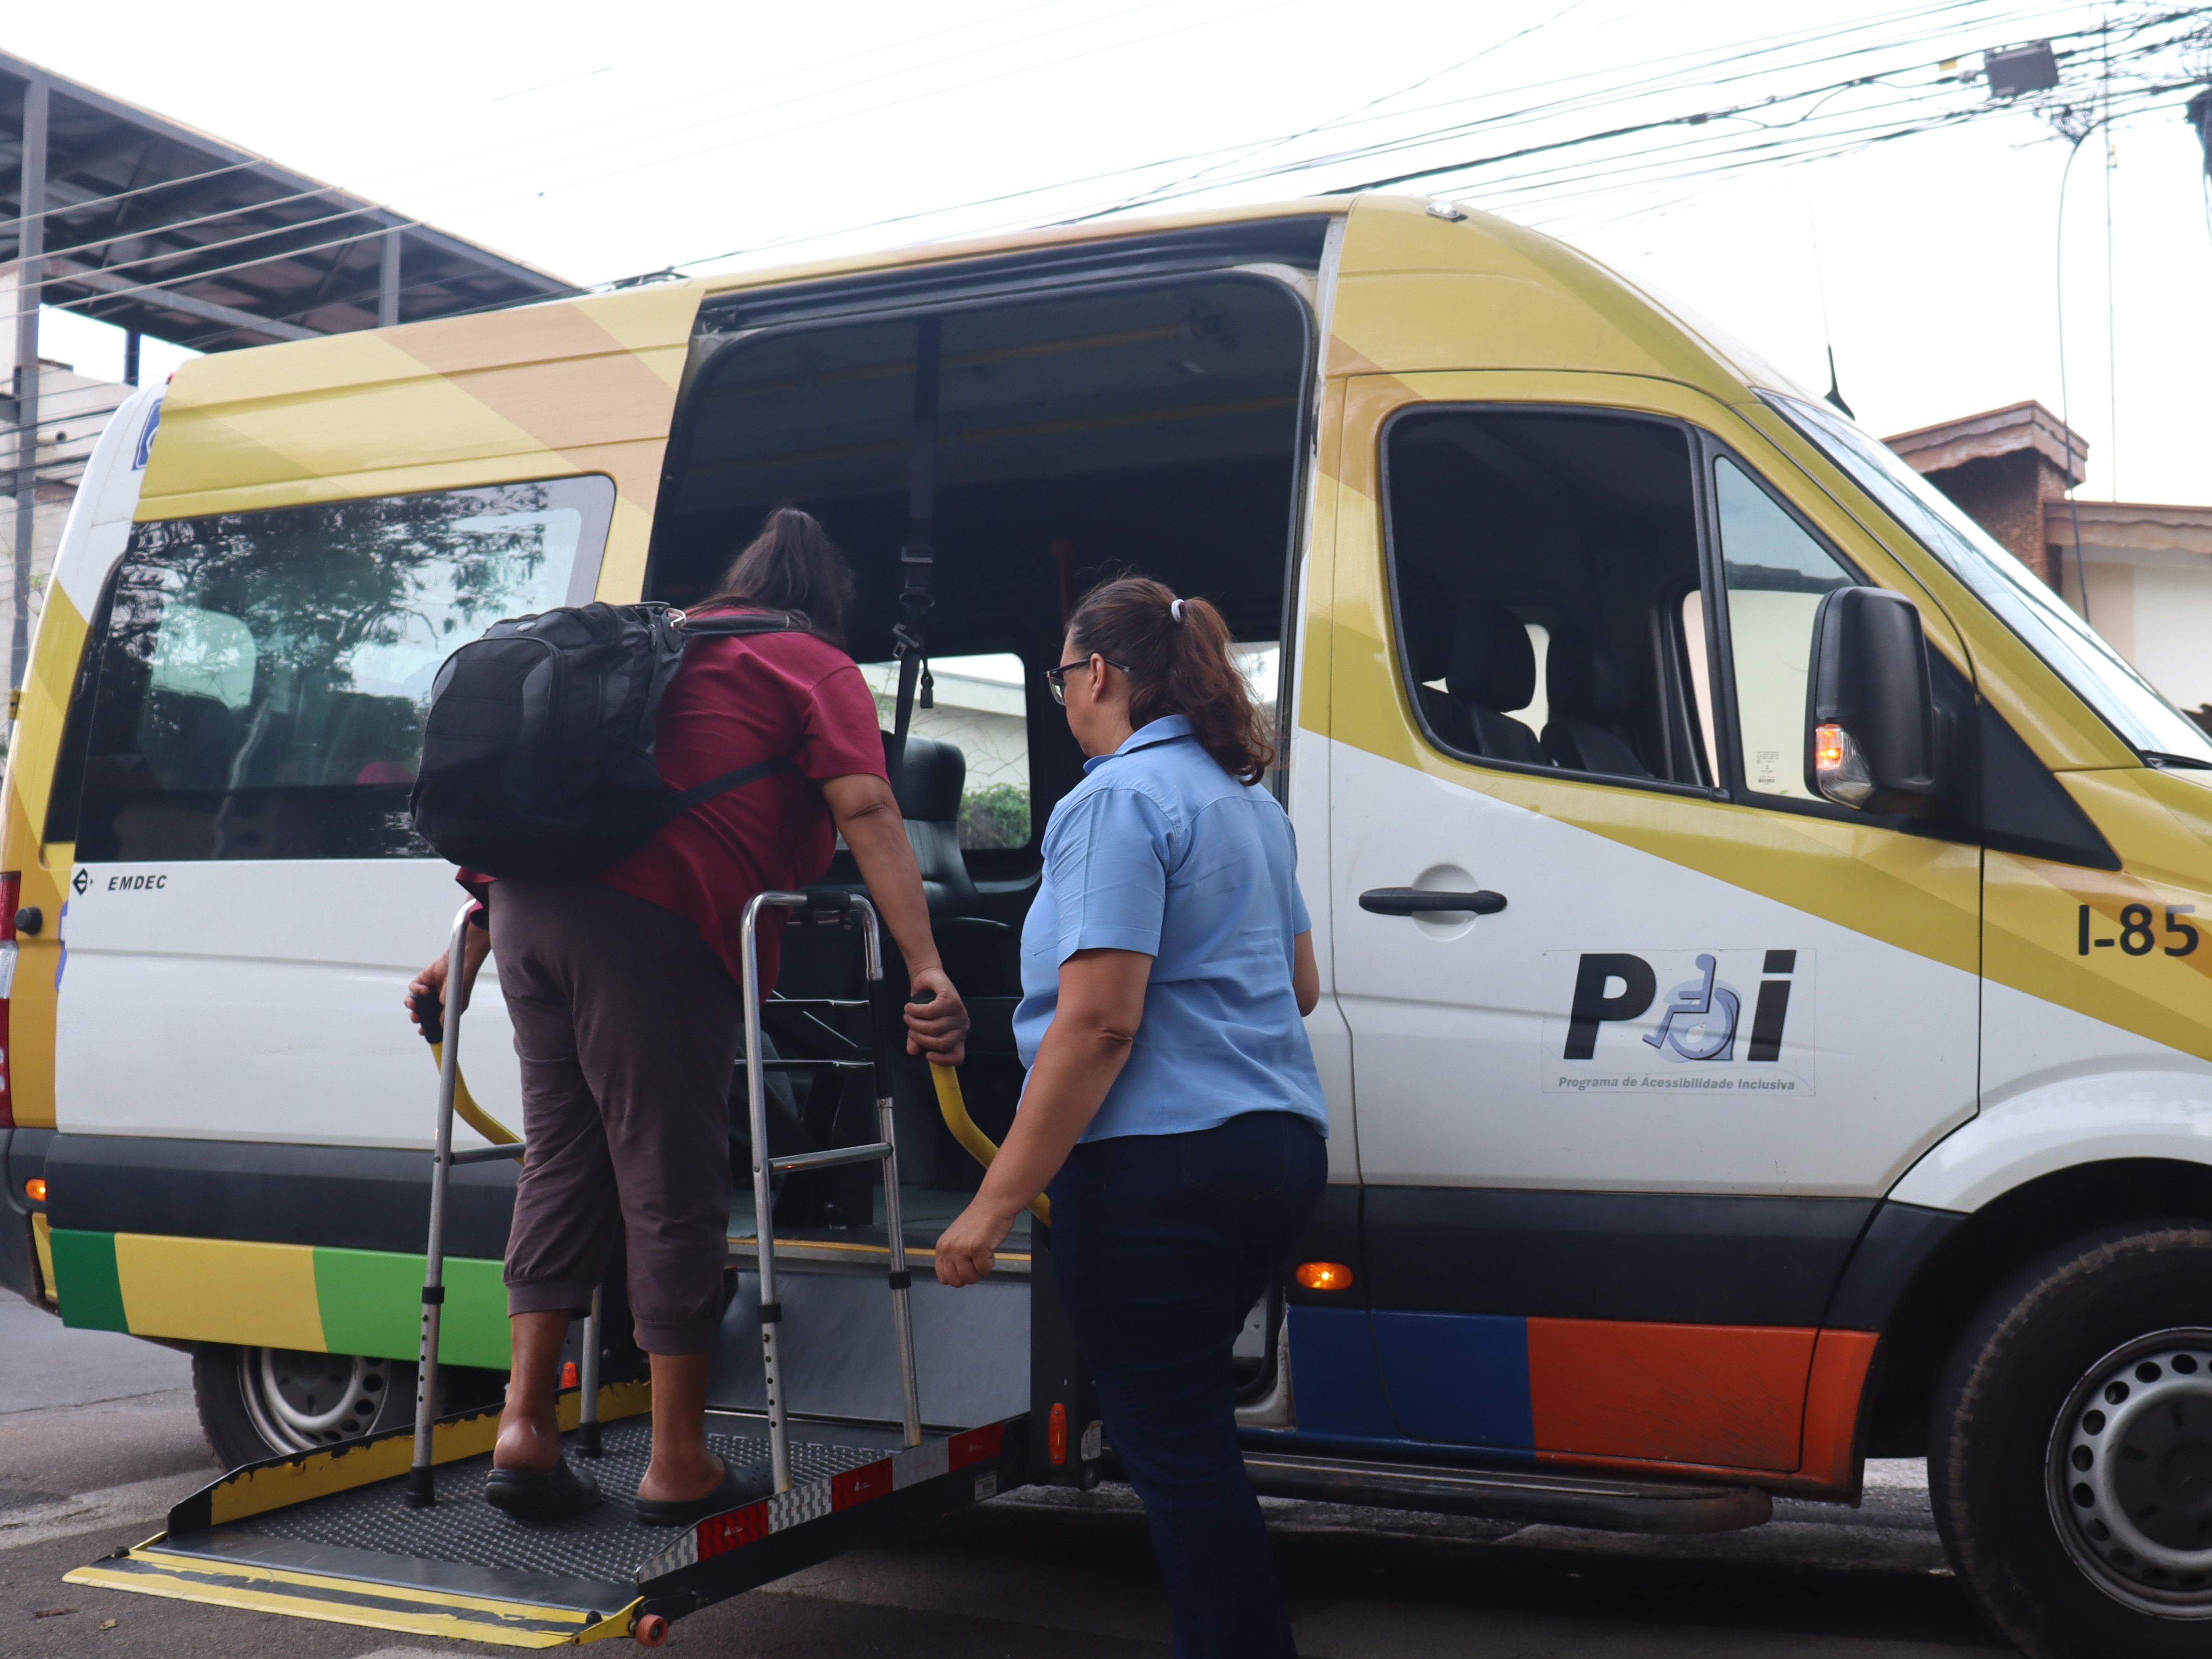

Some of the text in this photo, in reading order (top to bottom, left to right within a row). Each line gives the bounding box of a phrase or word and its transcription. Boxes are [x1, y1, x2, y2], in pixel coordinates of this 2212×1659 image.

[107, 875, 167, 891] EMDEC
[2079, 903, 2199, 957] I-85
[1558, 1077, 1618, 1091] Programa
[1622, 1077, 1637, 1086] de
[1738, 1079, 1795, 1090] Inclusiva
